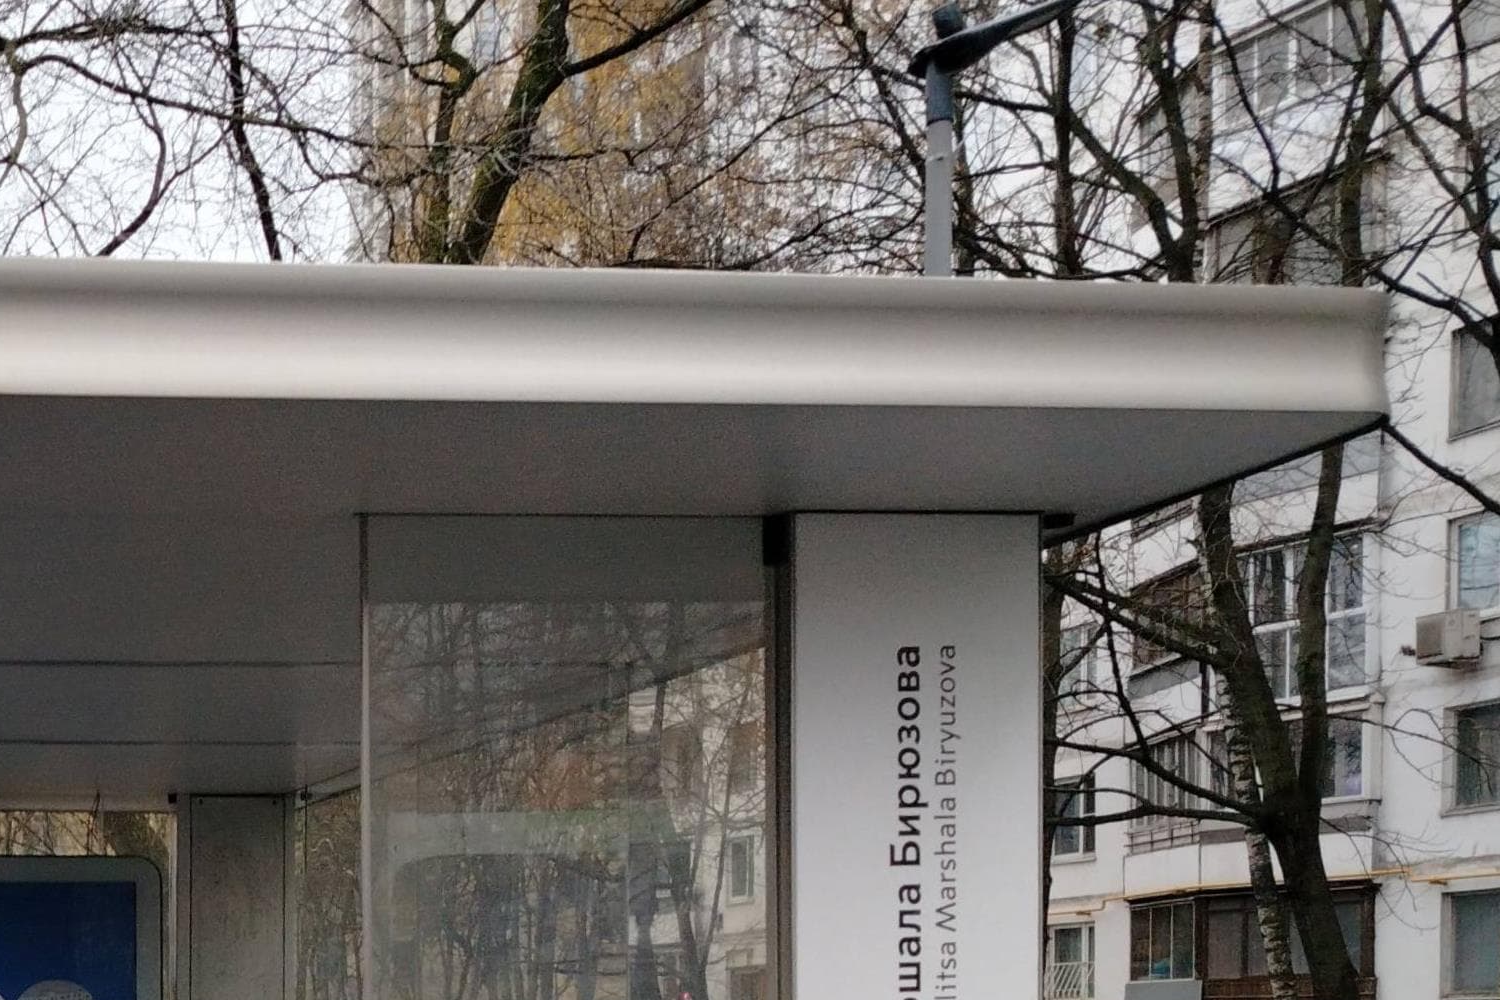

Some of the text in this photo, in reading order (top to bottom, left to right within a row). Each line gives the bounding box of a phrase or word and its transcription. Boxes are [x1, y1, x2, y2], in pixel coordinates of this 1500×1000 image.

[889, 645, 929, 867] Бирюзова
[934, 644, 963, 786] Biryuzova
[933, 797, 958, 933] Marshala
